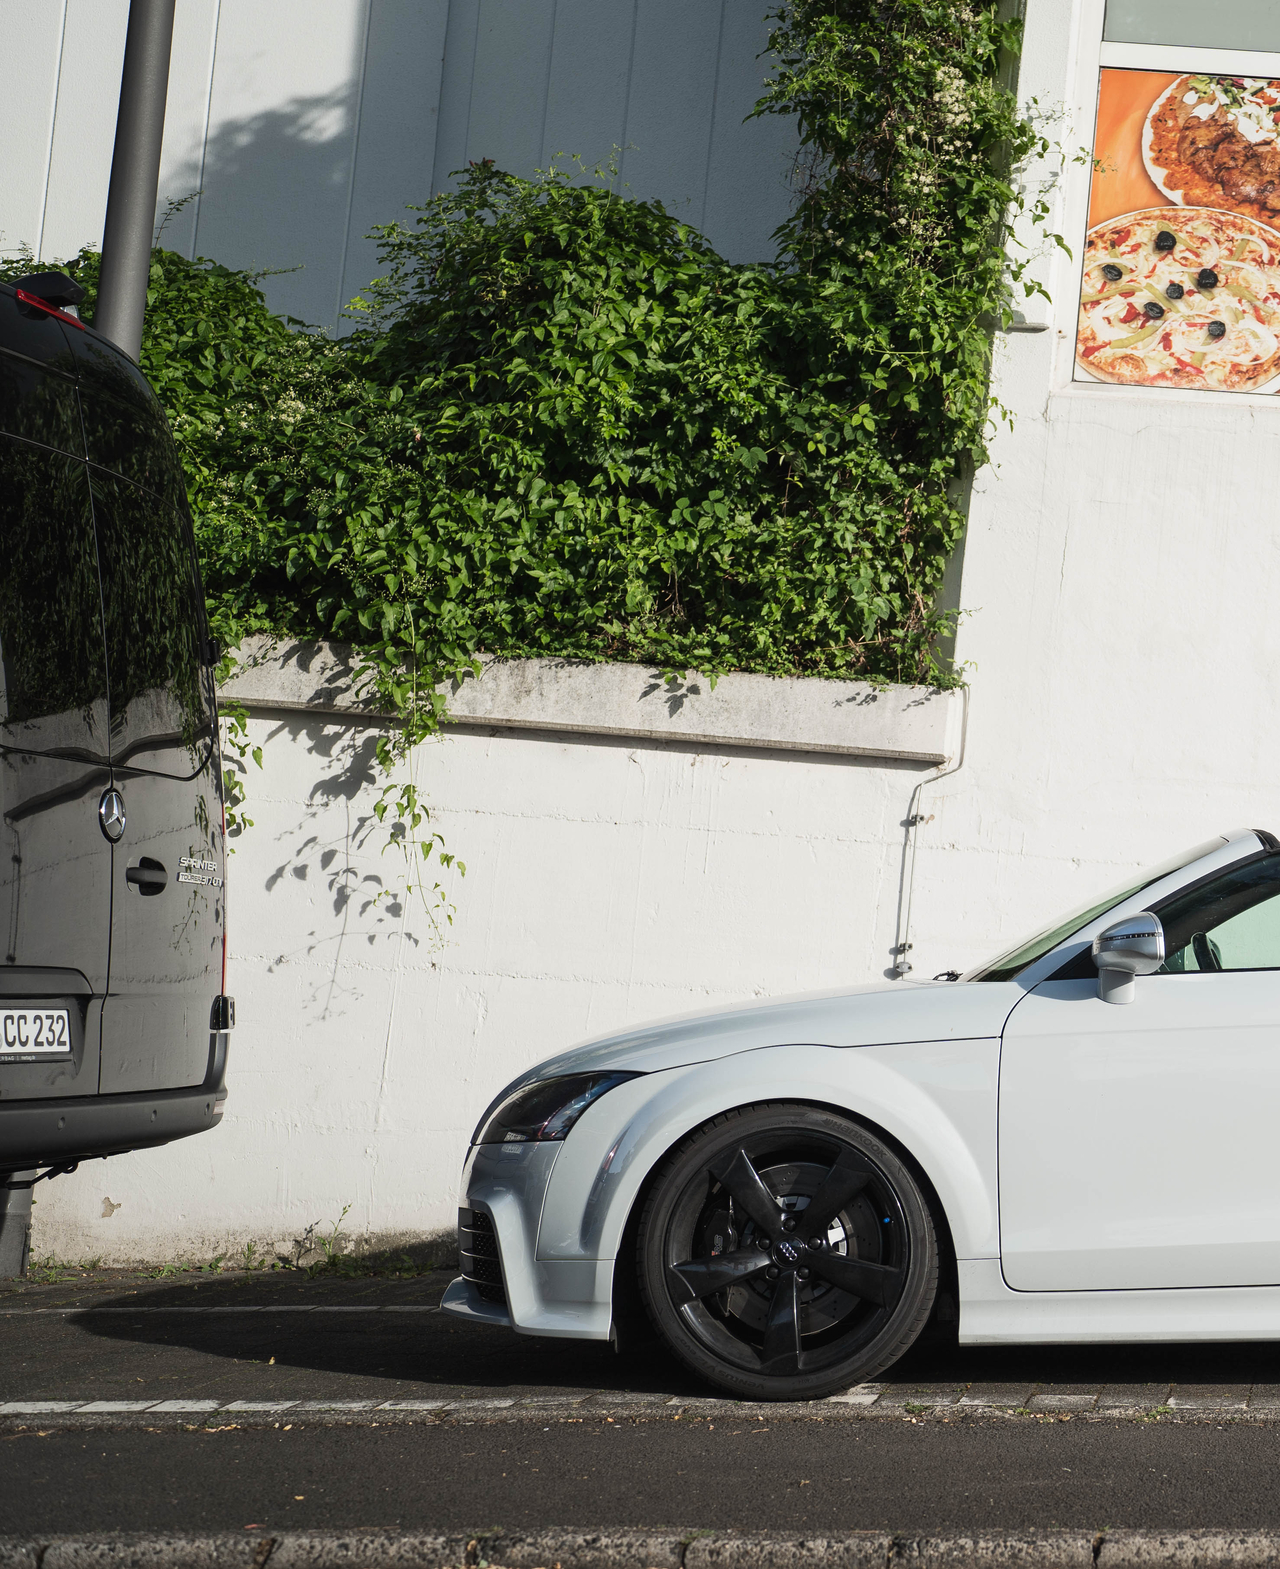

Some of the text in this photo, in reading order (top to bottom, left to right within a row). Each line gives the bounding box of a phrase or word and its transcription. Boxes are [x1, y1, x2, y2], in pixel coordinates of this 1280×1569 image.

[179, 857, 217, 871] SPRINTER
[4, 1014, 67, 1047] CC 232
